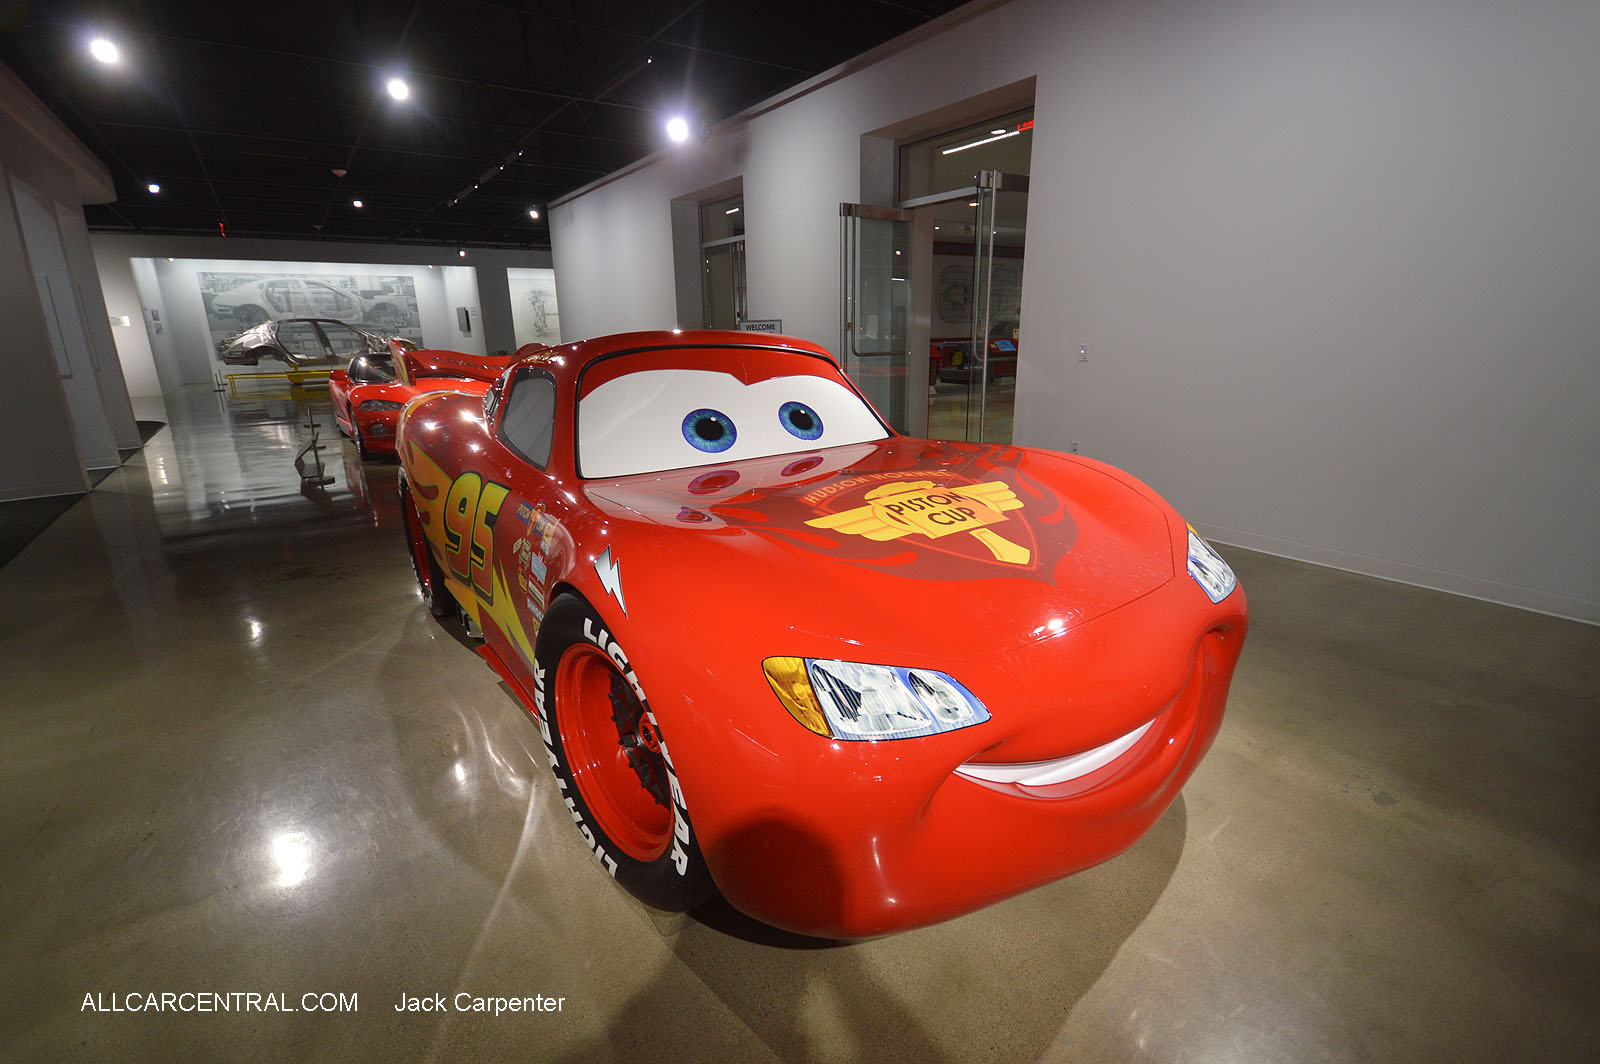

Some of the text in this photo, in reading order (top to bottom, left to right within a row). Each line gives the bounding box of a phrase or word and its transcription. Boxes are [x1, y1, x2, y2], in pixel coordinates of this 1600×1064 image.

[745, 323, 776, 331] WELCOME
[803, 469, 952, 504] HUDSON HORNET
[884, 491, 969, 516] PISTON
[927, 506, 977, 526] CUP
[444, 470, 512, 607] 95
